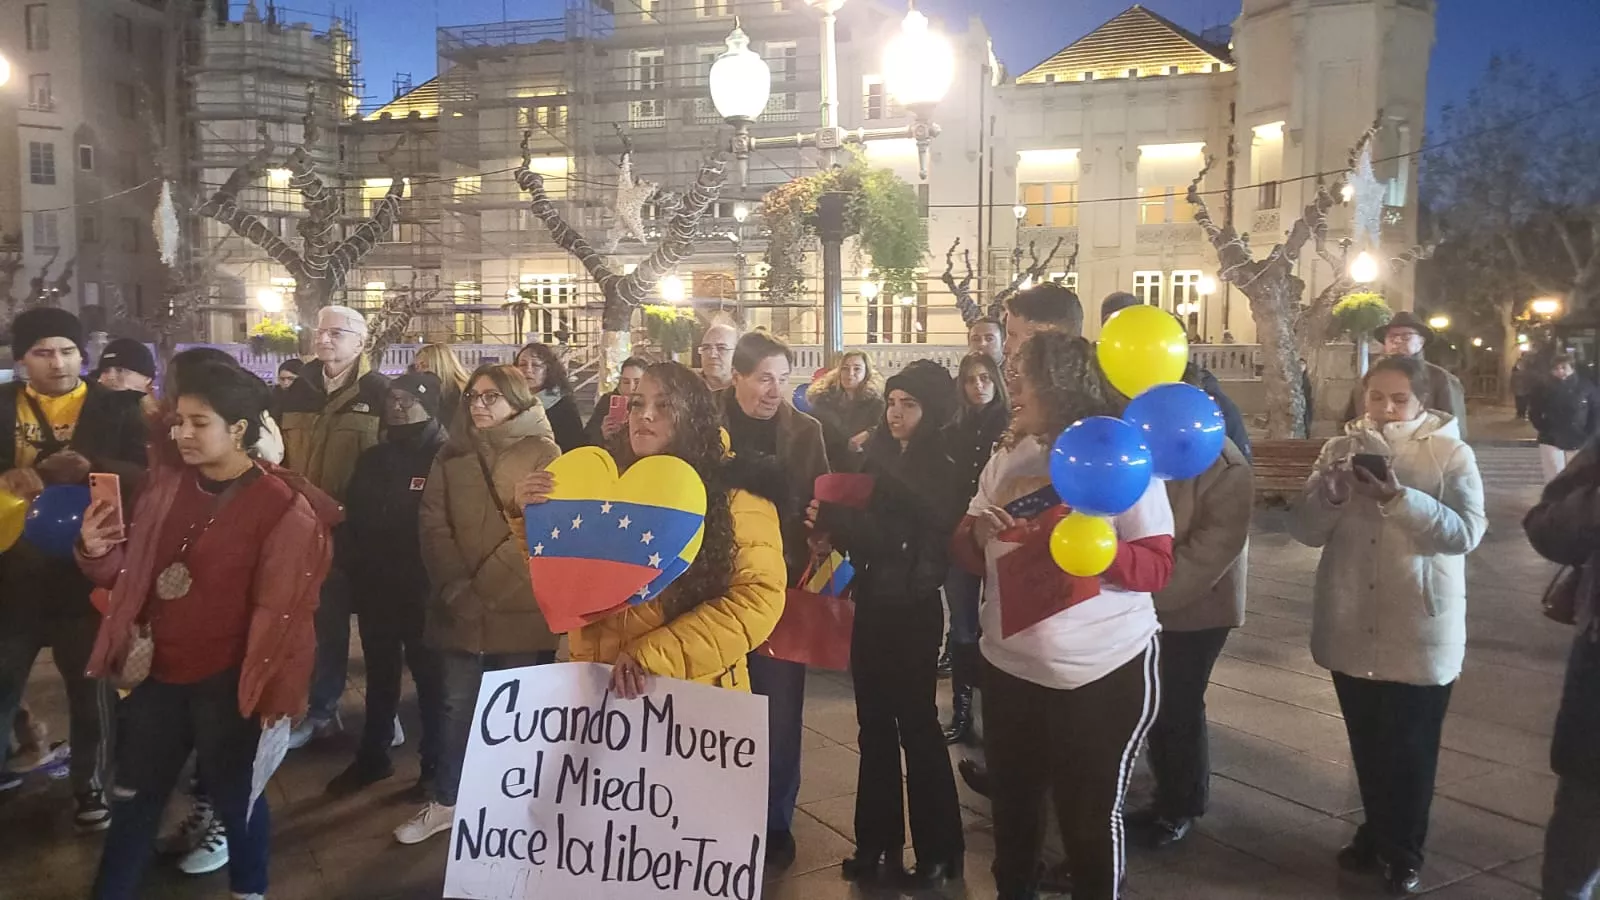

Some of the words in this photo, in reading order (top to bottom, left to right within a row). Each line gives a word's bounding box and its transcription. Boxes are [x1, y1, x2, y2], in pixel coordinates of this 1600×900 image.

[481, 678, 631, 751] Cuando
[640, 693, 756, 768] Muere
[501, 750, 544, 799] el
[555, 753, 679, 830] Miedo,
[455, 806, 547, 866] Nace
[556, 812, 594, 876] la
